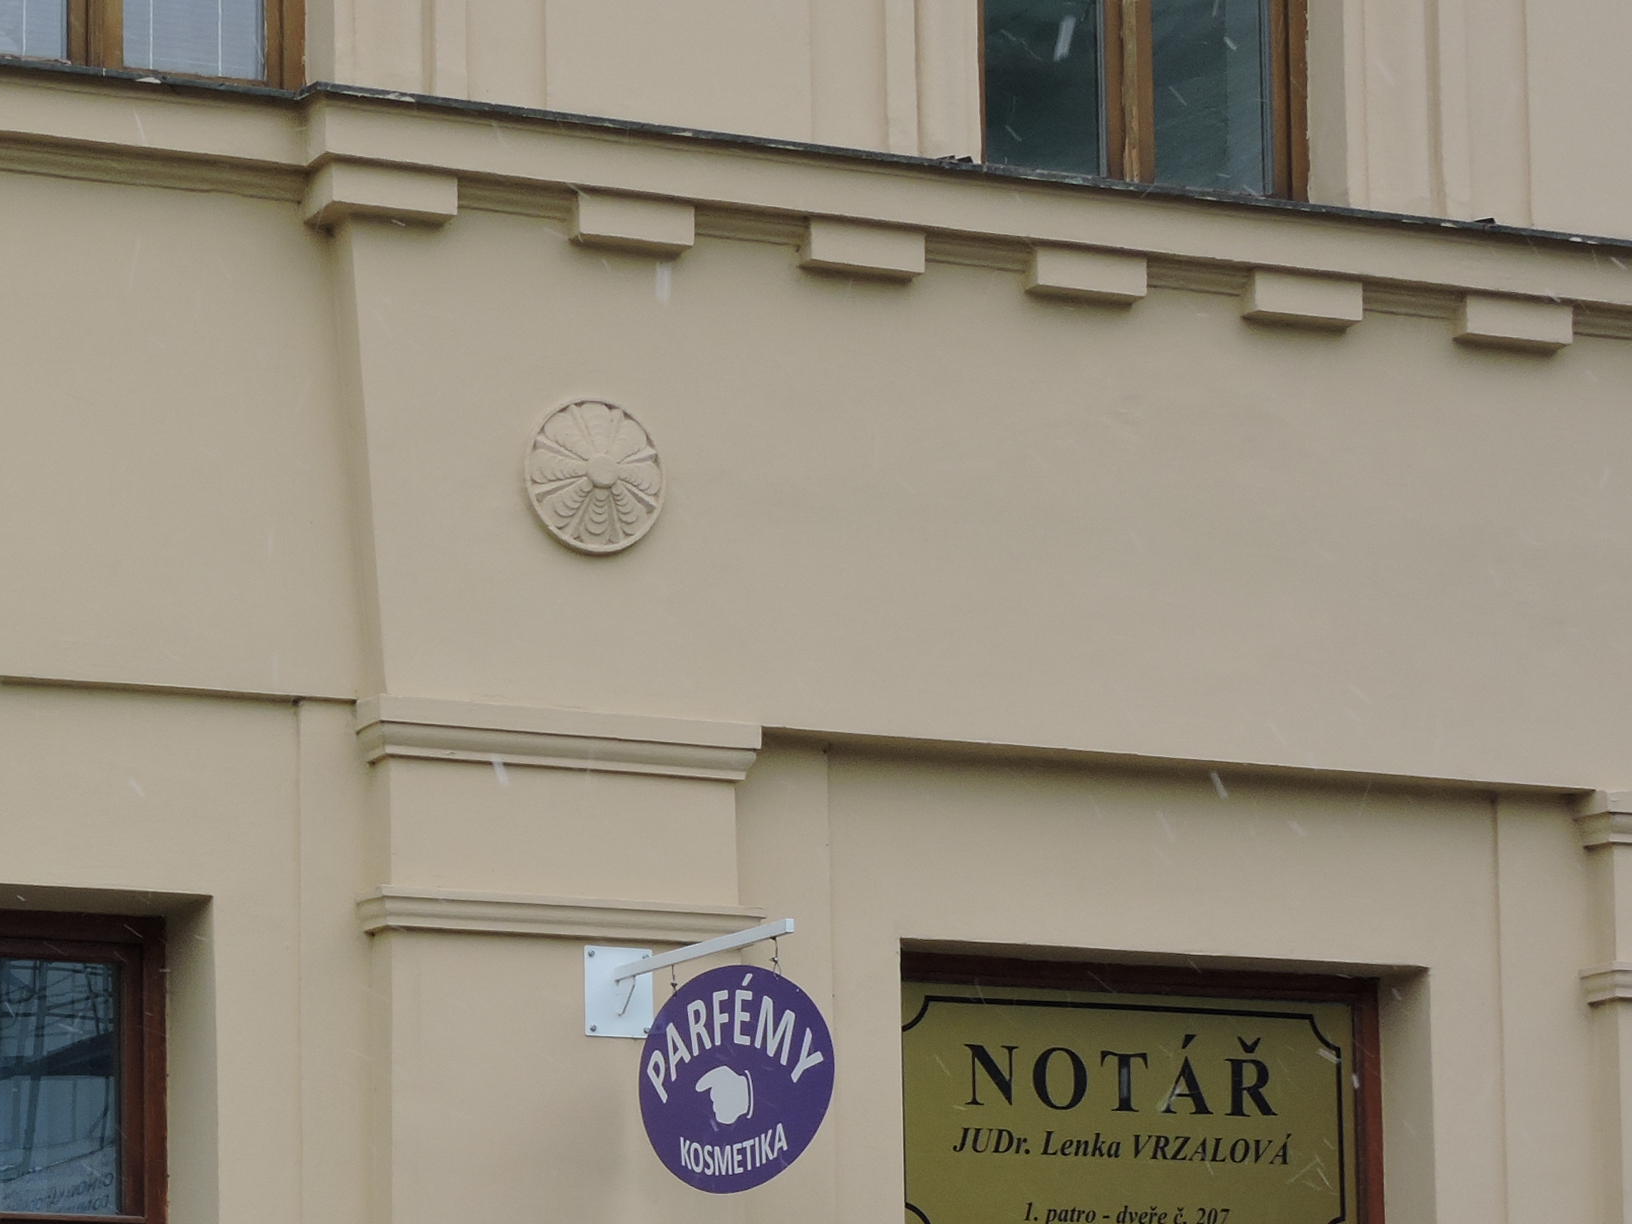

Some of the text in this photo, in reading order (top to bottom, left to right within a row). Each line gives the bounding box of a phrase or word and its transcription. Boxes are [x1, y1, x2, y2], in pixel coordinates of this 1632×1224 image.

[646, 973, 824, 1104] PARFÉMY
[964, 1034, 1278, 1117] NOTÁŘ
[679, 1122, 788, 1176] KOSMETIKA
[953, 1126, 1292, 1166] JUDr. Lenka VRZALOVÁ
[1023, 1202, 1039, 1222] 1.
